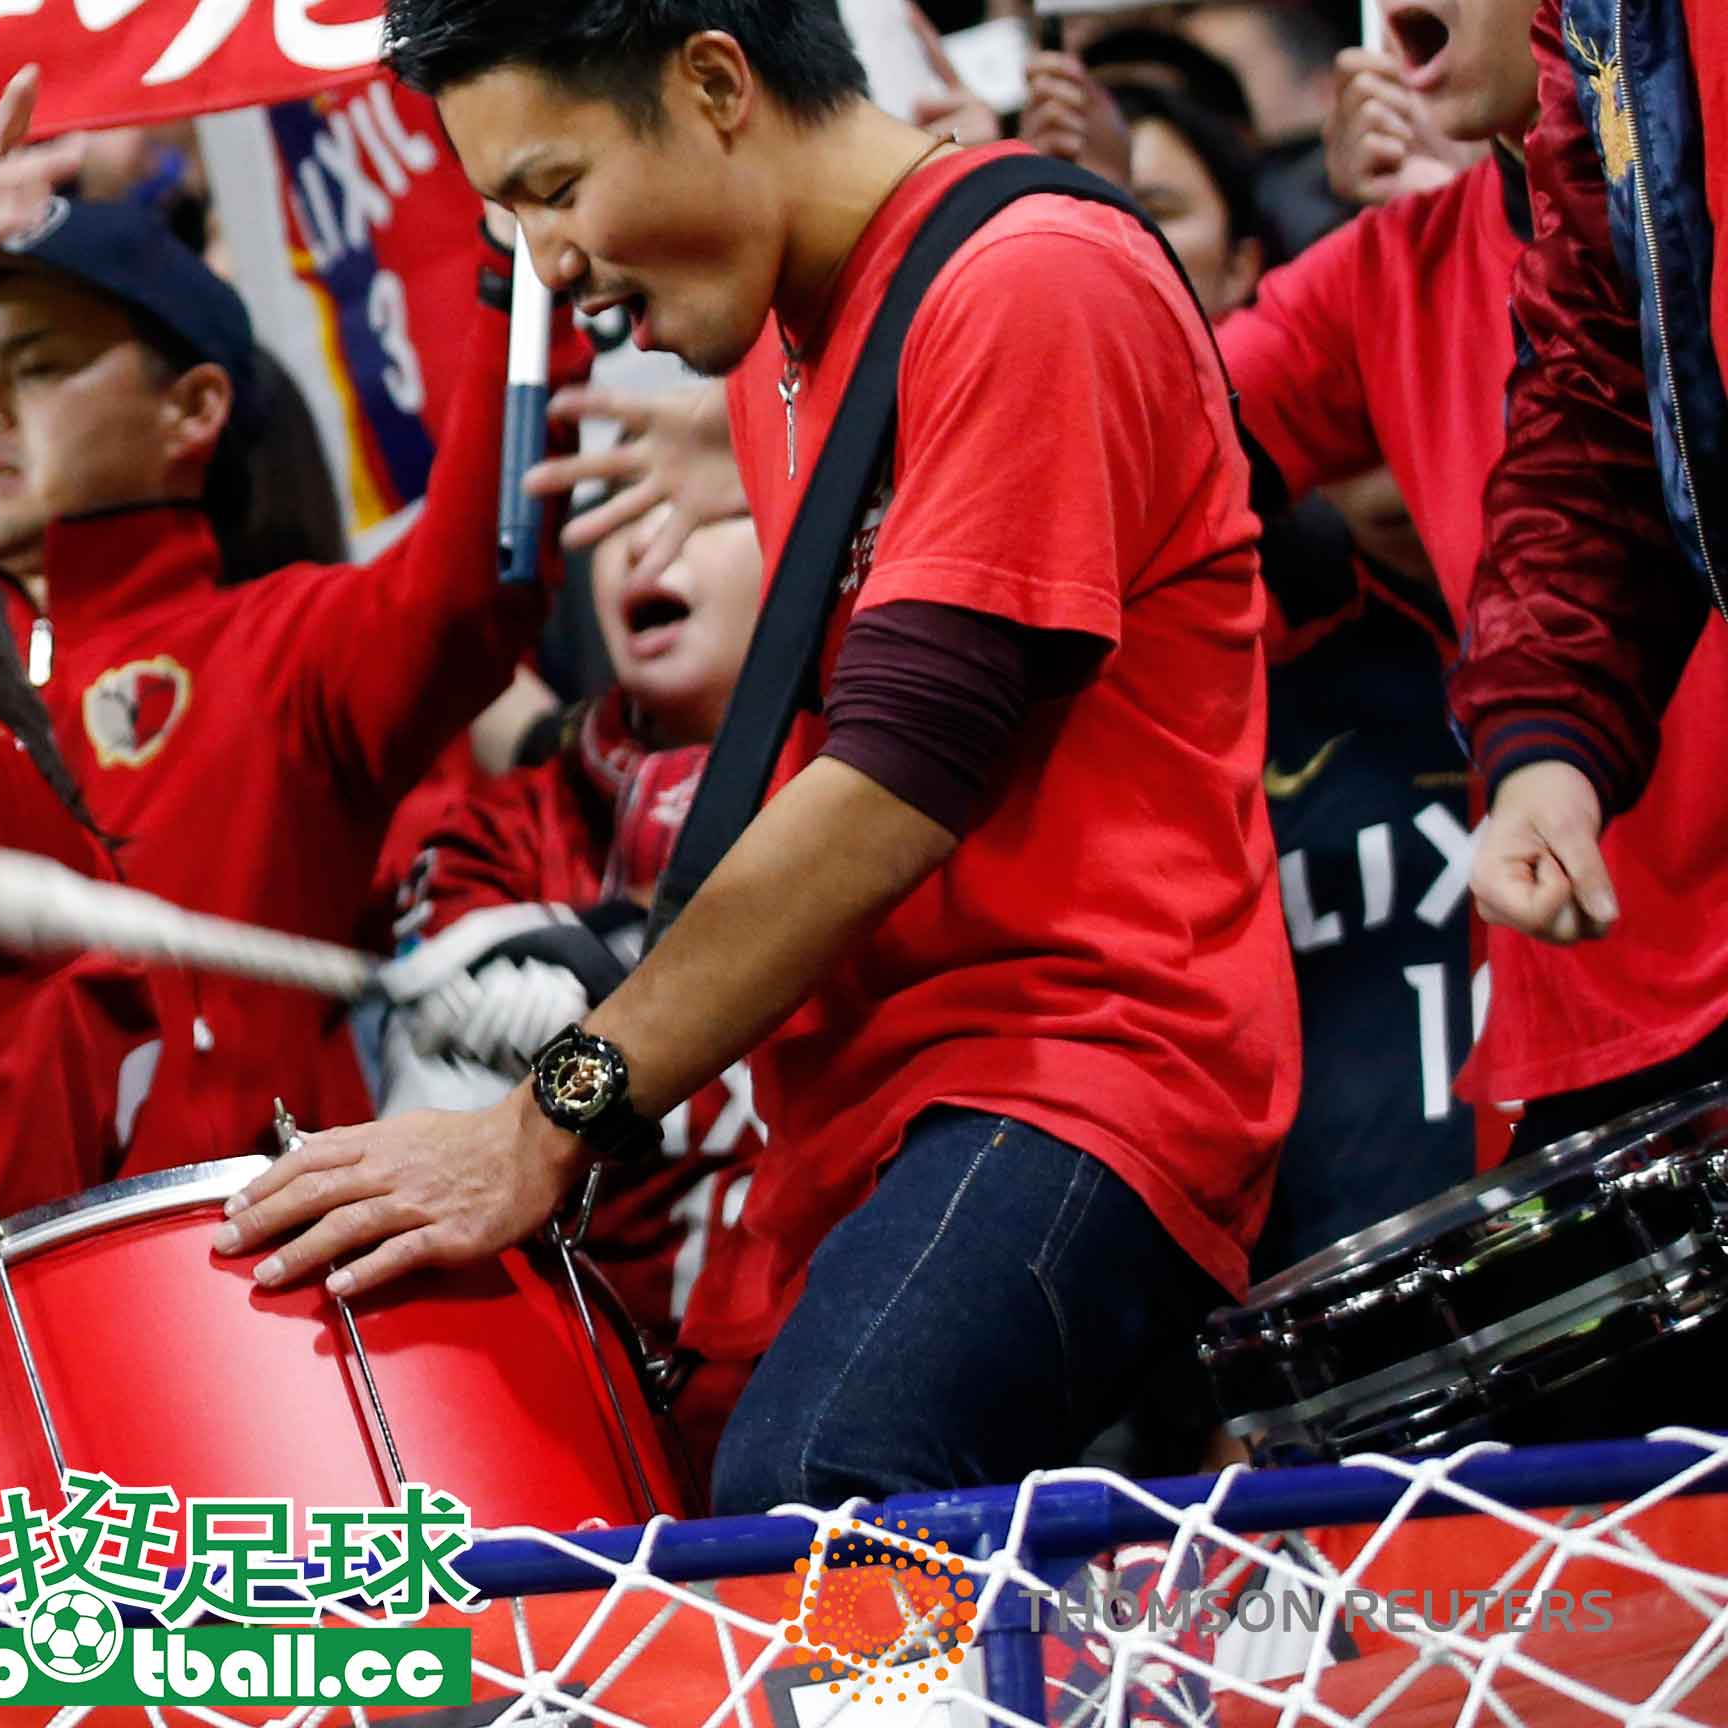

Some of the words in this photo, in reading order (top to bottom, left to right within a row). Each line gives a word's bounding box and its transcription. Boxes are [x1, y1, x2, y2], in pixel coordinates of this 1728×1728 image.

[288, 80, 440, 274] LIXIL
[366, 268, 428, 416] 3
[1403, 961, 1492, 1123] 1
